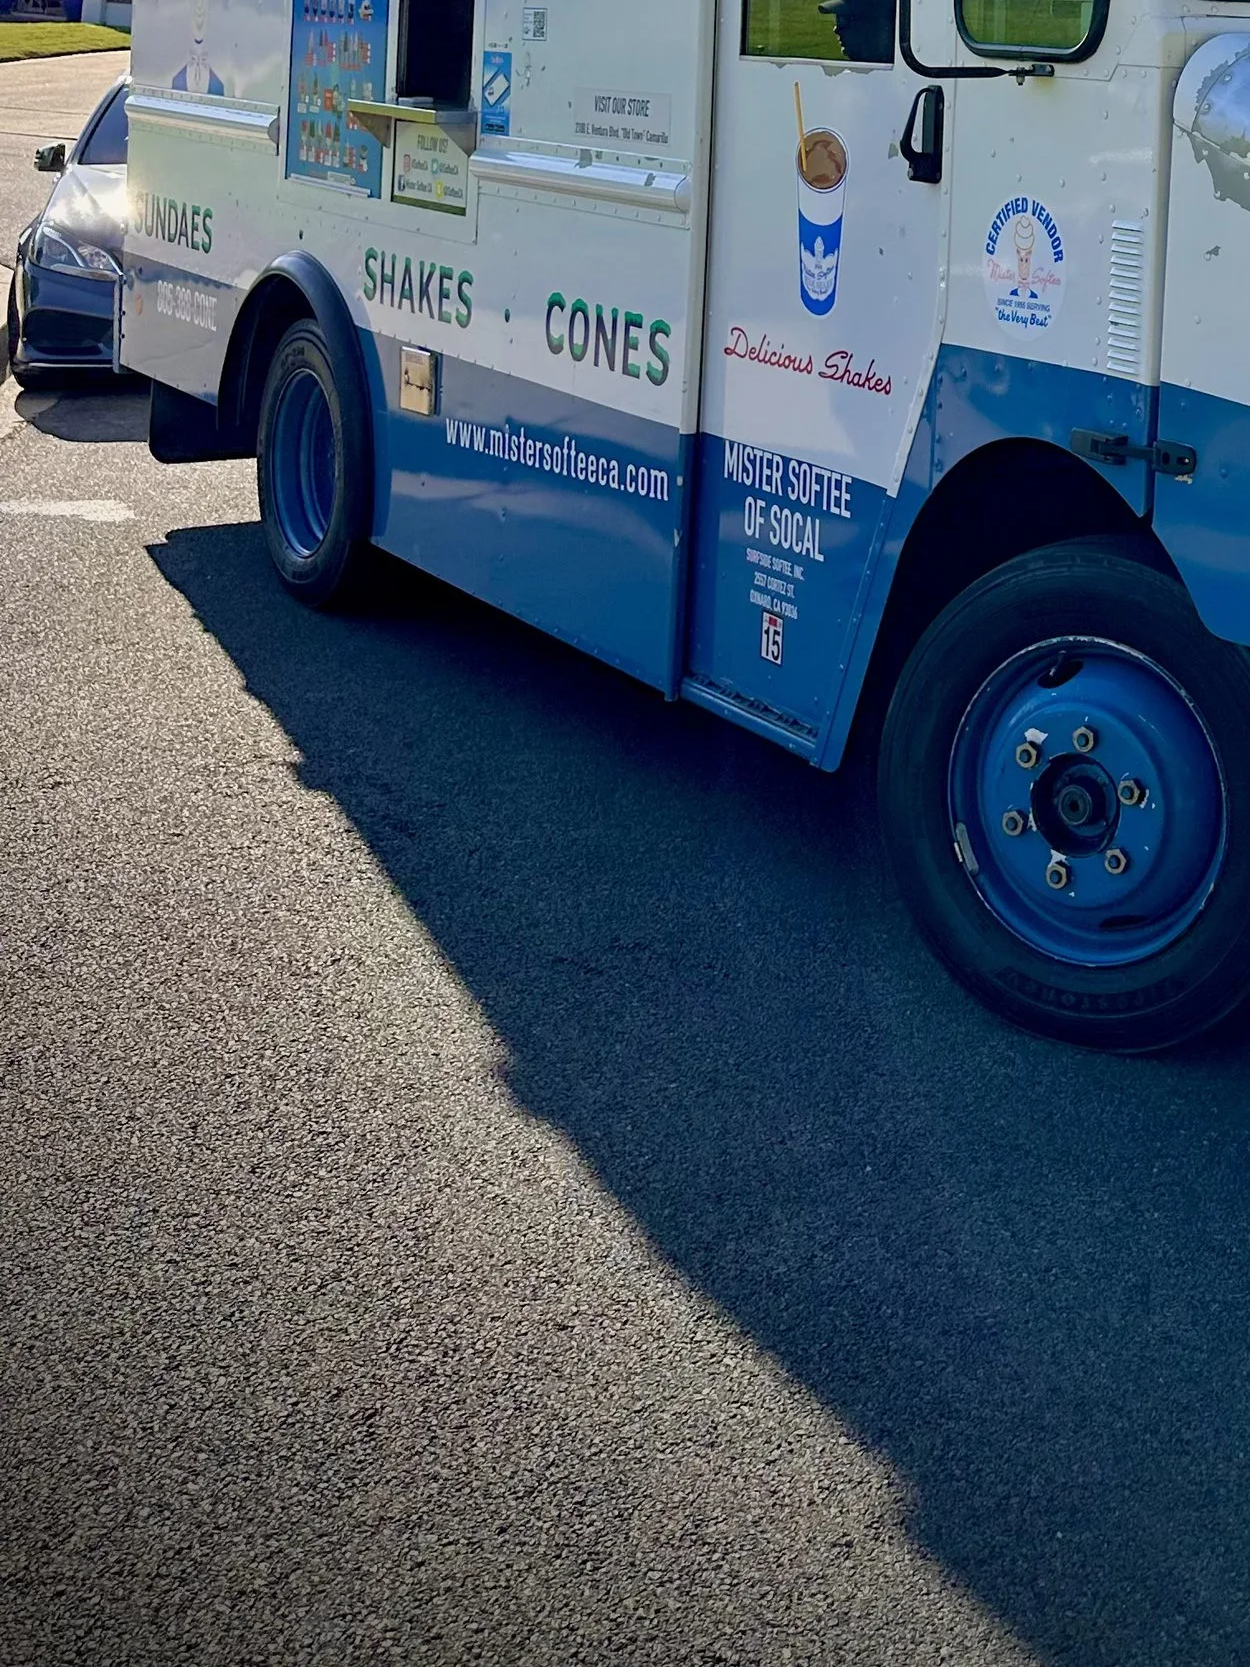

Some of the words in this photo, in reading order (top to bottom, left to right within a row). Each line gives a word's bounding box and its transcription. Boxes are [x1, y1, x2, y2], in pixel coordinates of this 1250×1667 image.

[594, 95, 611, 113] VISIT
[612, 97, 626, 115] OUR
[627, 98, 650, 117] STORE
[134, 191, 213, 254] SUNDAES
[985, 197, 1029, 256] CERTIFIED
[1031, 199, 1064, 263] VENDOR
[987, 258, 1016, 283] Mister
[1031, 266, 1062, 293] Softee
[997, 298, 1013, 308] SINCE
[1026, 302, 1051, 313] SERVING
[363, 247, 474, 329] SHAKES
[545, 291, 672, 386] CONES
[1011, 309, 1029, 329] Very
[723, 326, 813, 375] Delicious
[818, 350, 892, 395] Shakes
[445, 417, 669, 502] www.mistersofteeca.com
[724, 439, 783, 496] MISTER
[788, 459, 852, 519] SOFTEE
[744, 496, 766, 539] OF
[769, 504, 825, 562] SOCAL
[764, 625, 781, 662] 15
